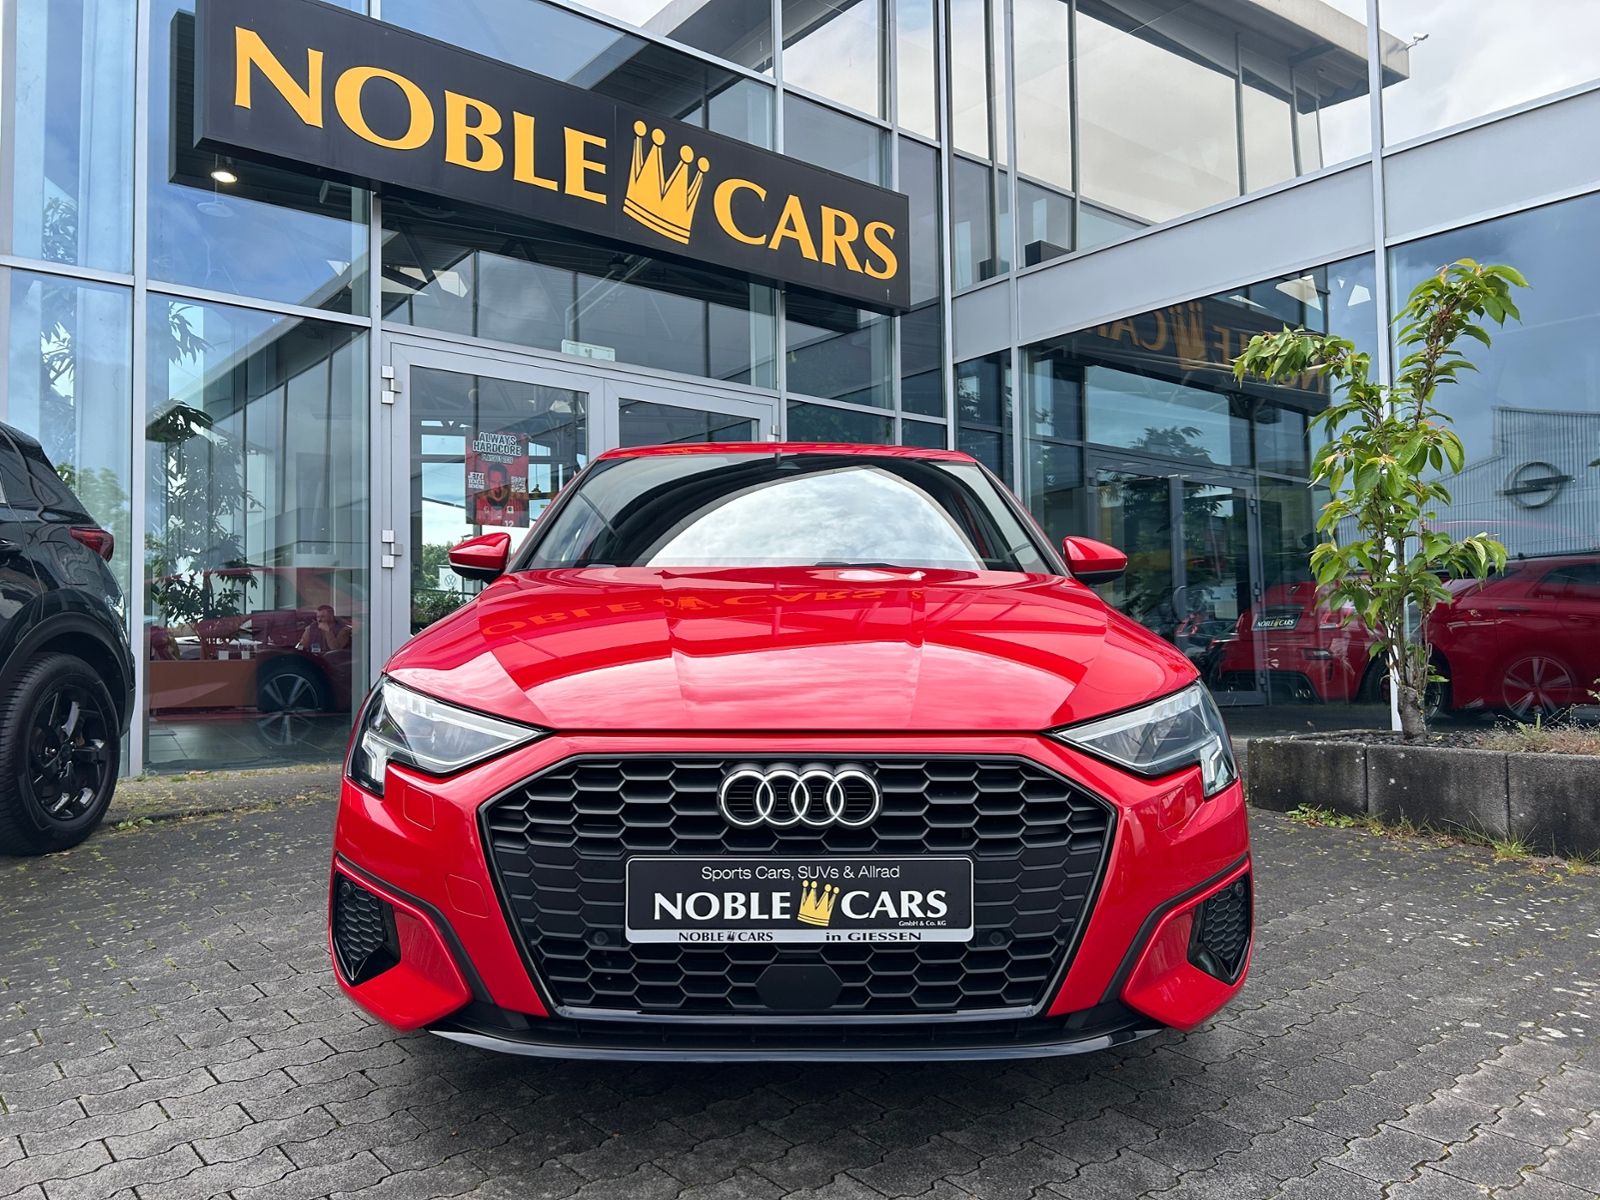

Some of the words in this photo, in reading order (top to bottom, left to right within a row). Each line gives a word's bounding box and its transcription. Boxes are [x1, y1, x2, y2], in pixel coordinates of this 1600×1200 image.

[234, 26, 607, 204] NOBLE
[713, 178, 898, 280] CARS
[479, 432, 516, 445] ALWAYS
[473, 441, 521, 455] HARDCORE
[701, 866, 751, 882] Sports
[755, 866, 795, 880] Cars,
[797, 865, 839, 879] SUVs
[842, 865, 855, 879] &
[858, 865, 900, 879] Allrad
[654, 892, 791, 920] NOBLE
[841, 890, 948, 919] CARS
[678, 931, 724, 941] NOBLE
[738, 931, 773, 941] CARS
[826, 932, 842, 941] in
[847, 932, 922, 941] GIESSEN
